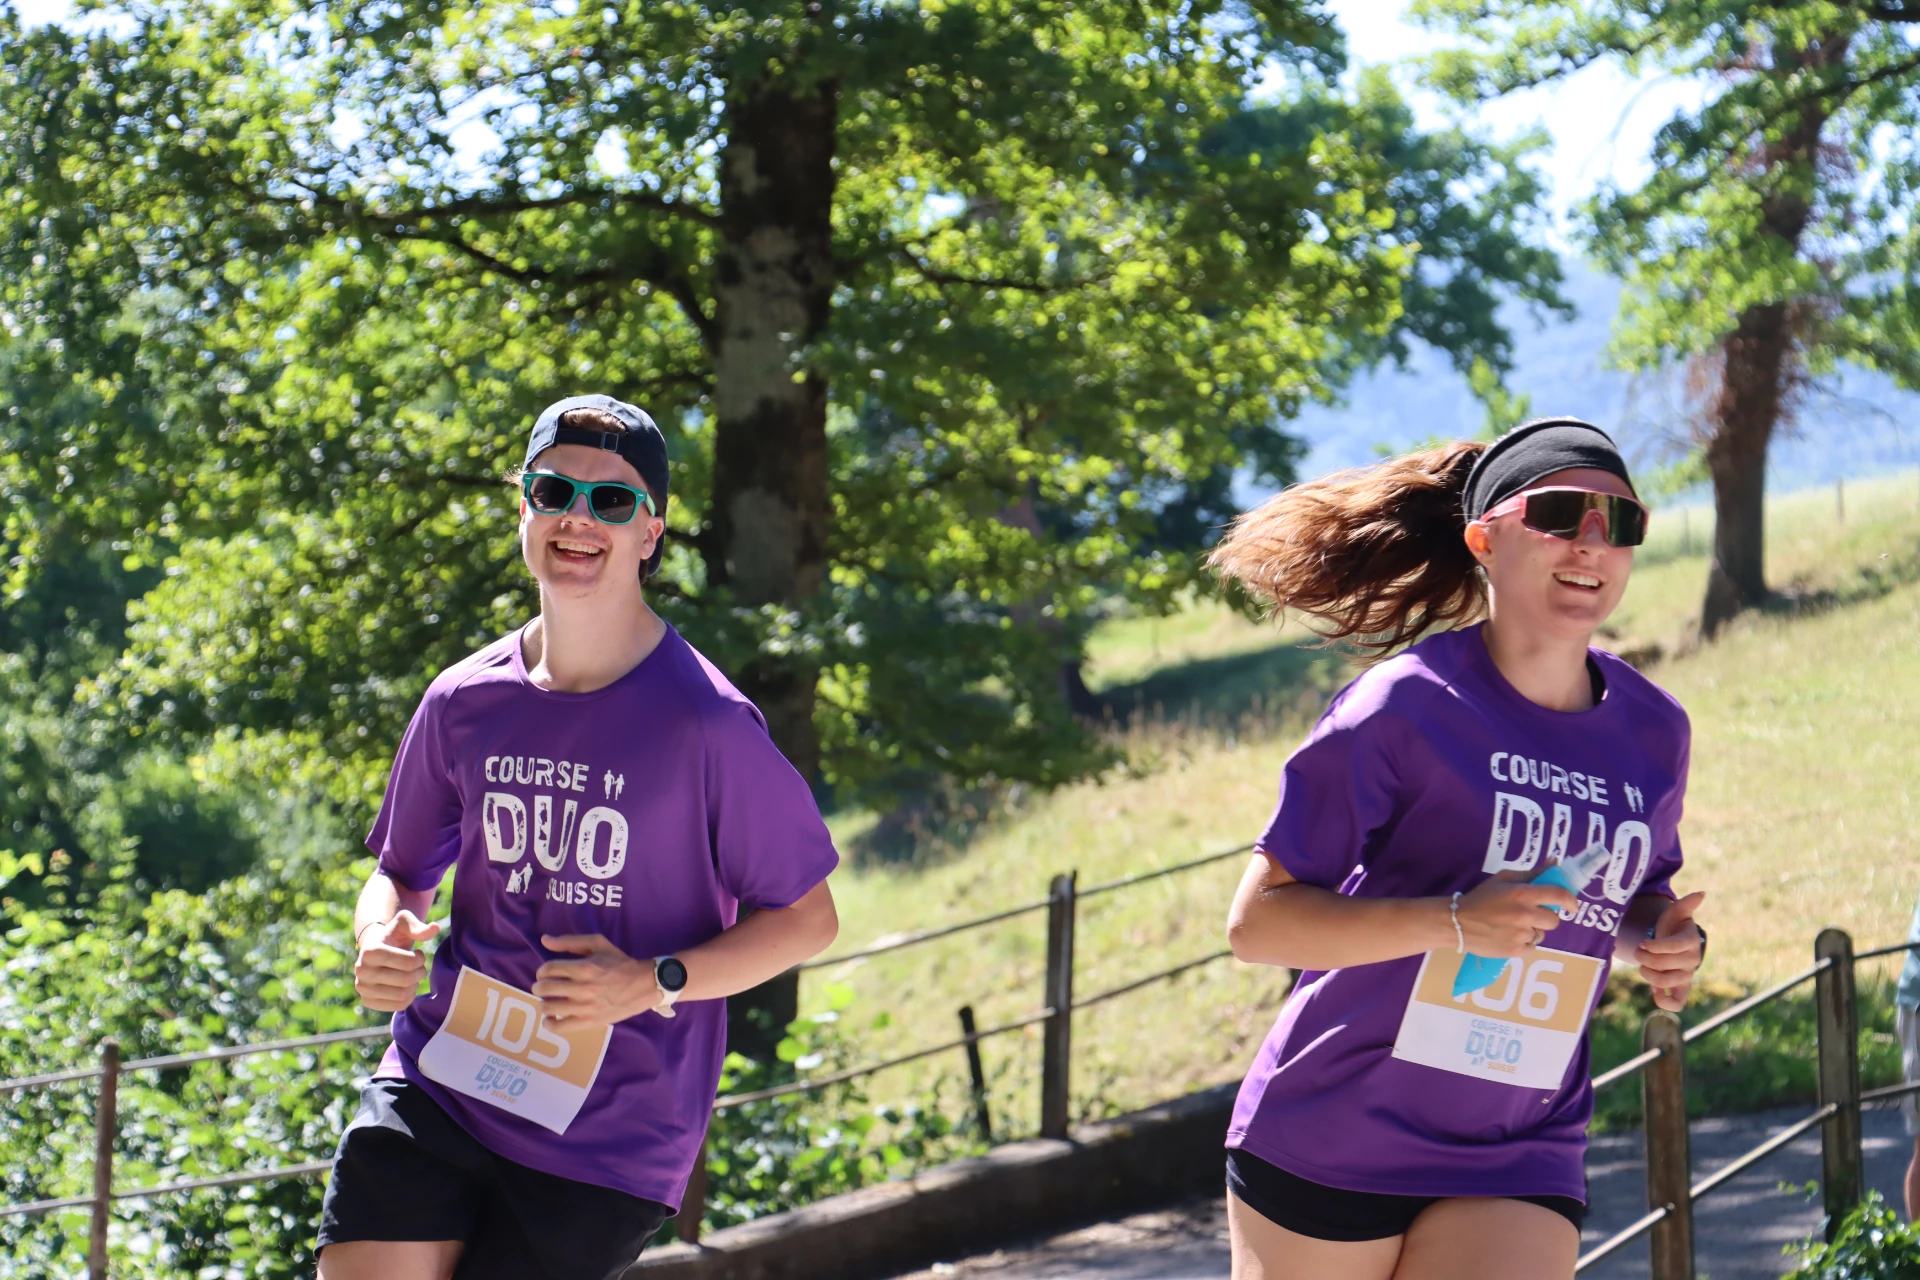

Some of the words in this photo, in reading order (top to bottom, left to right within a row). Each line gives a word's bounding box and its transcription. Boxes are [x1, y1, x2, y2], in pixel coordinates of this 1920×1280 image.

[485, 755, 590, 792] COURSE
[1490, 751, 1610, 806] COURSE
[483, 791, 629, 880] DUO
[1452, 956, 1565, 1021] 06
[476, 987, 571, 1069] 105
[1464, 1030, 1523, 1065] DUO
[475, 1063, 528, 1097] DUO
[486, 1054, 521, 1074] COURSE
